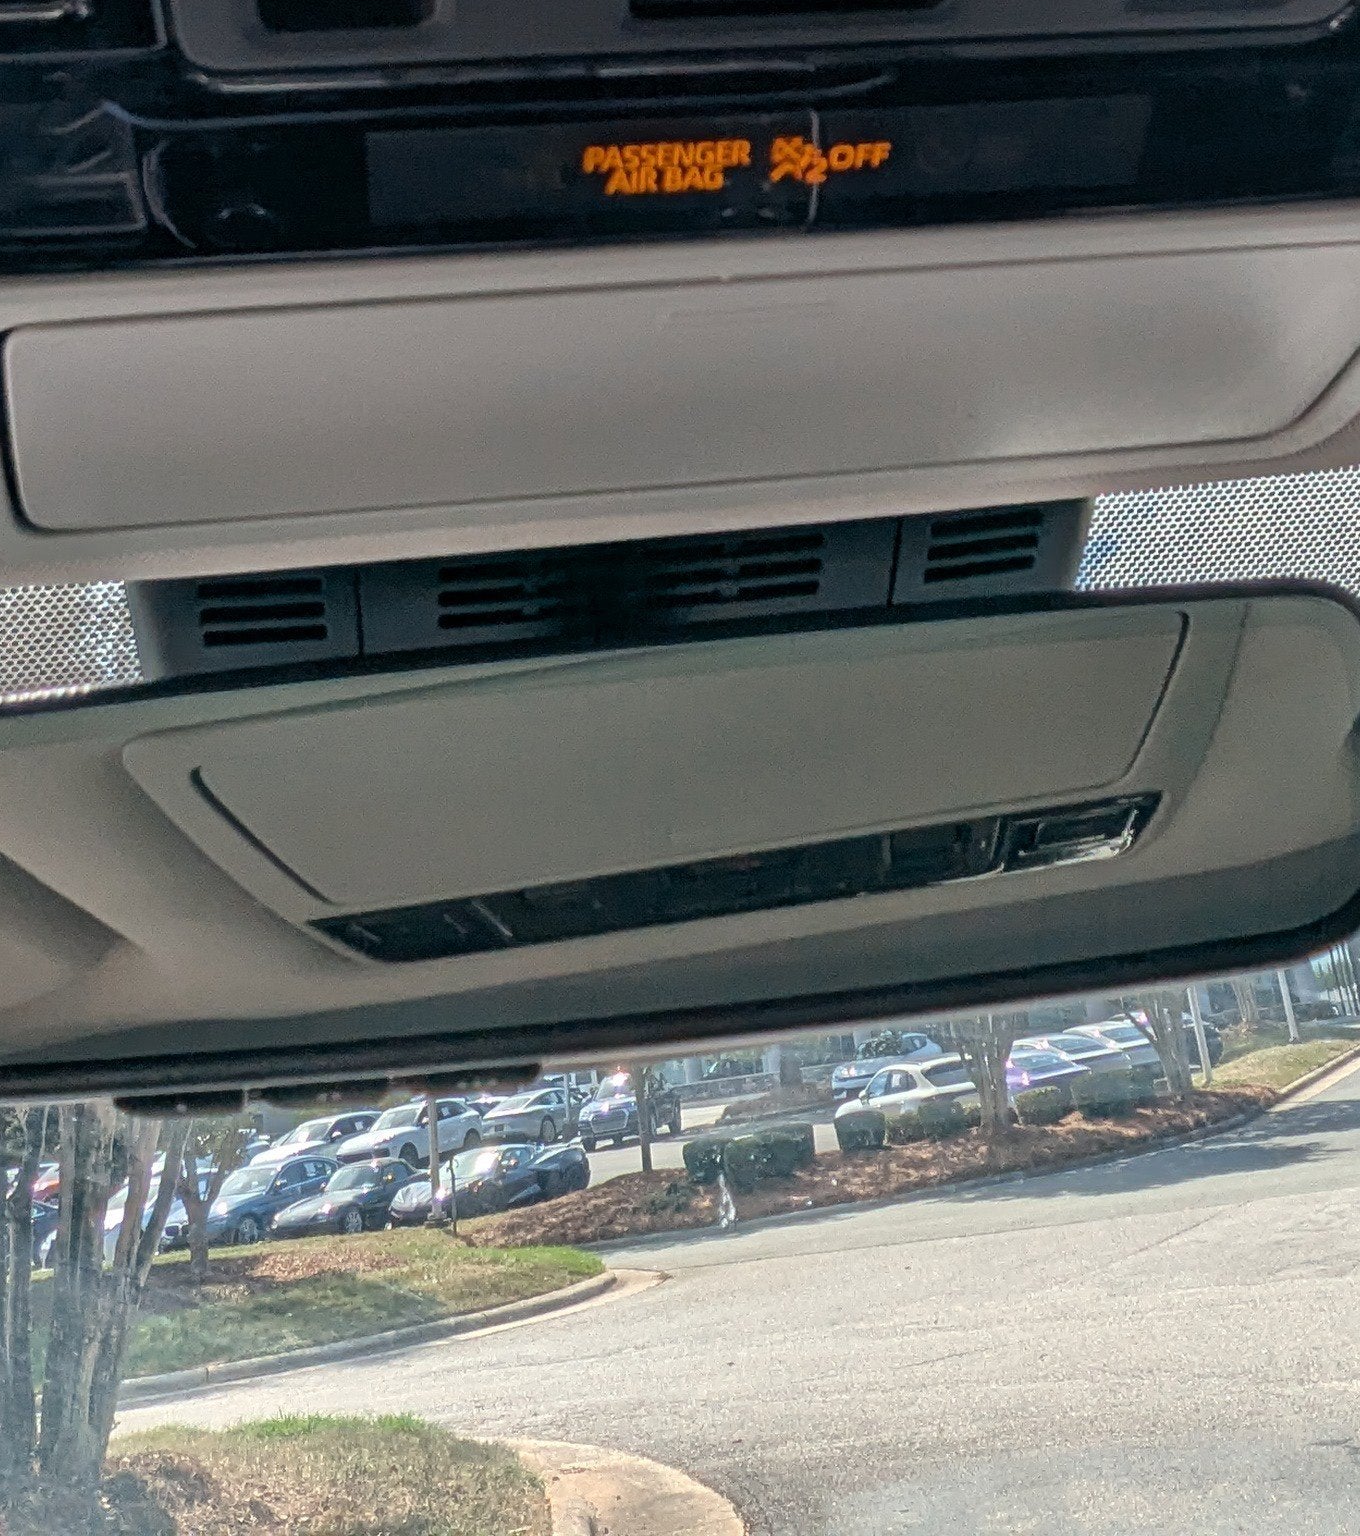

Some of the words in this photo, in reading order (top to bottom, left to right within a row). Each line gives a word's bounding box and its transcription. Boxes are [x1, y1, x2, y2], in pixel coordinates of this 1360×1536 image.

[583, 138, 751, 173] PASSENGER
[829, 141, 890, 170] OFF
[604, 166, 657, 195] AIR
[664, 165, 724, 193] BAG
